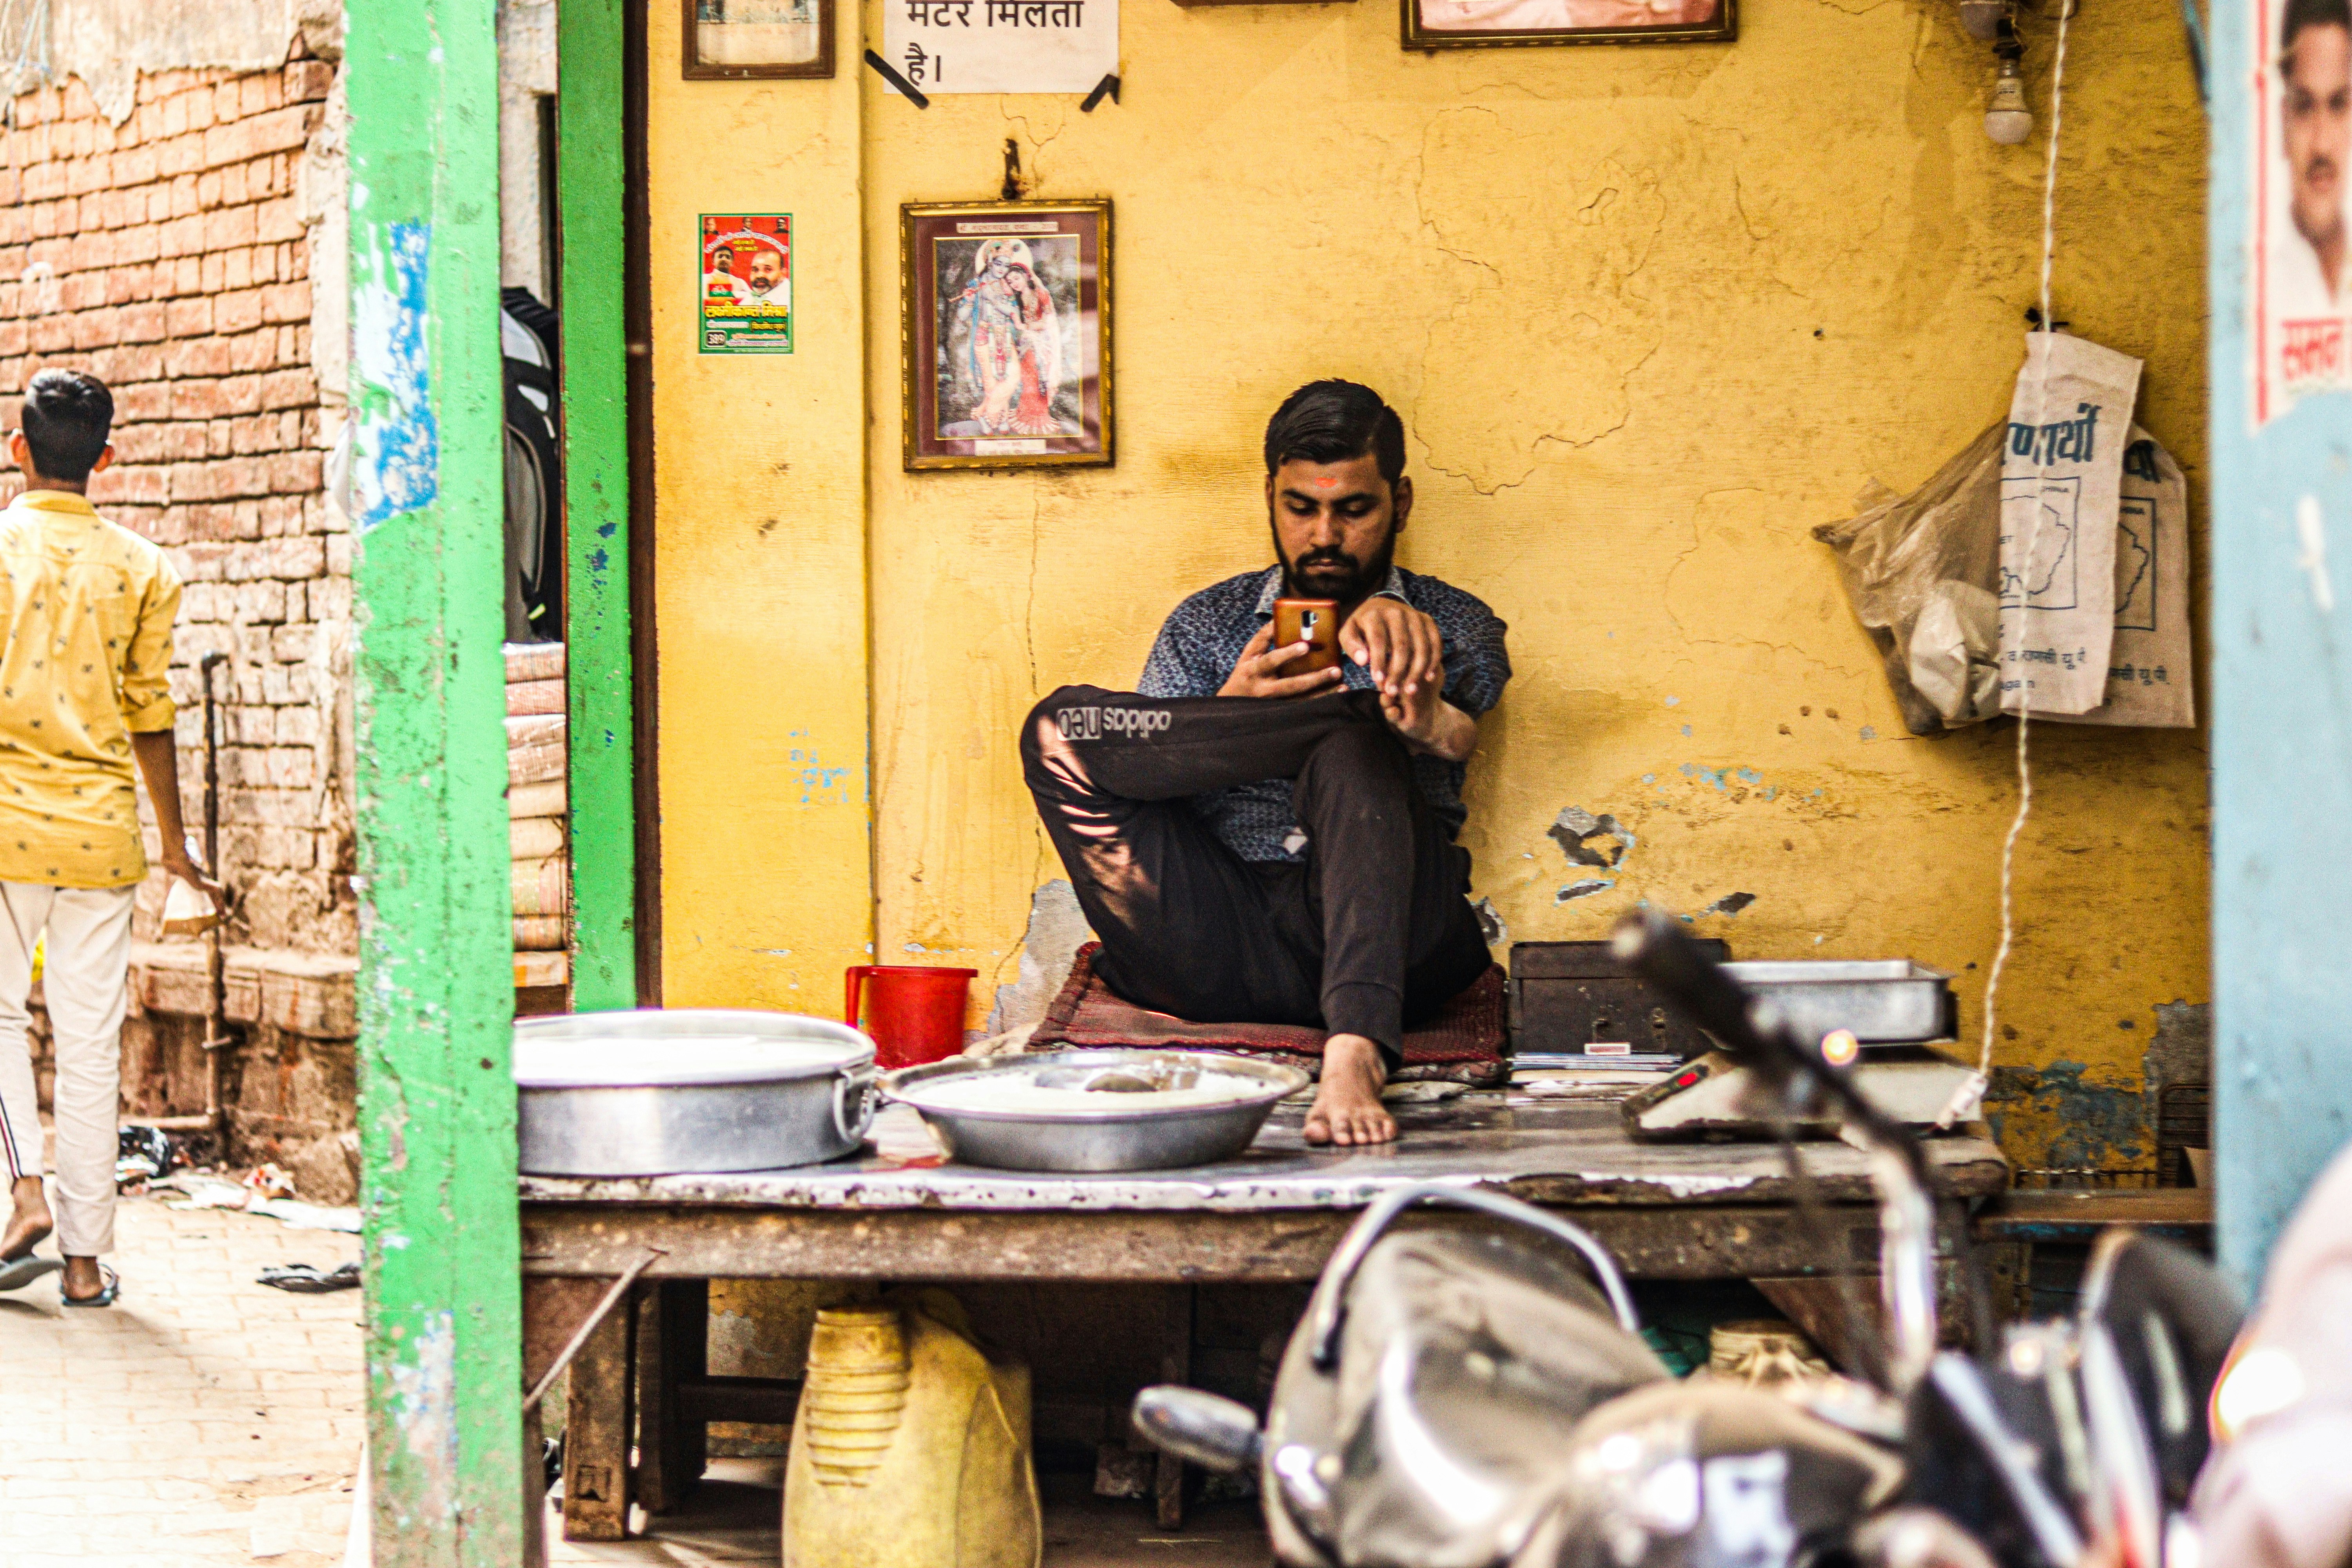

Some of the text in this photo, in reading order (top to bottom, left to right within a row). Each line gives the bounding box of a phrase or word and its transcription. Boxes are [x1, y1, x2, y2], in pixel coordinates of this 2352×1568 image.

[906, 0, 1084, 27] मटर मिलता
[1102, 707, 1172, 738] adidas
